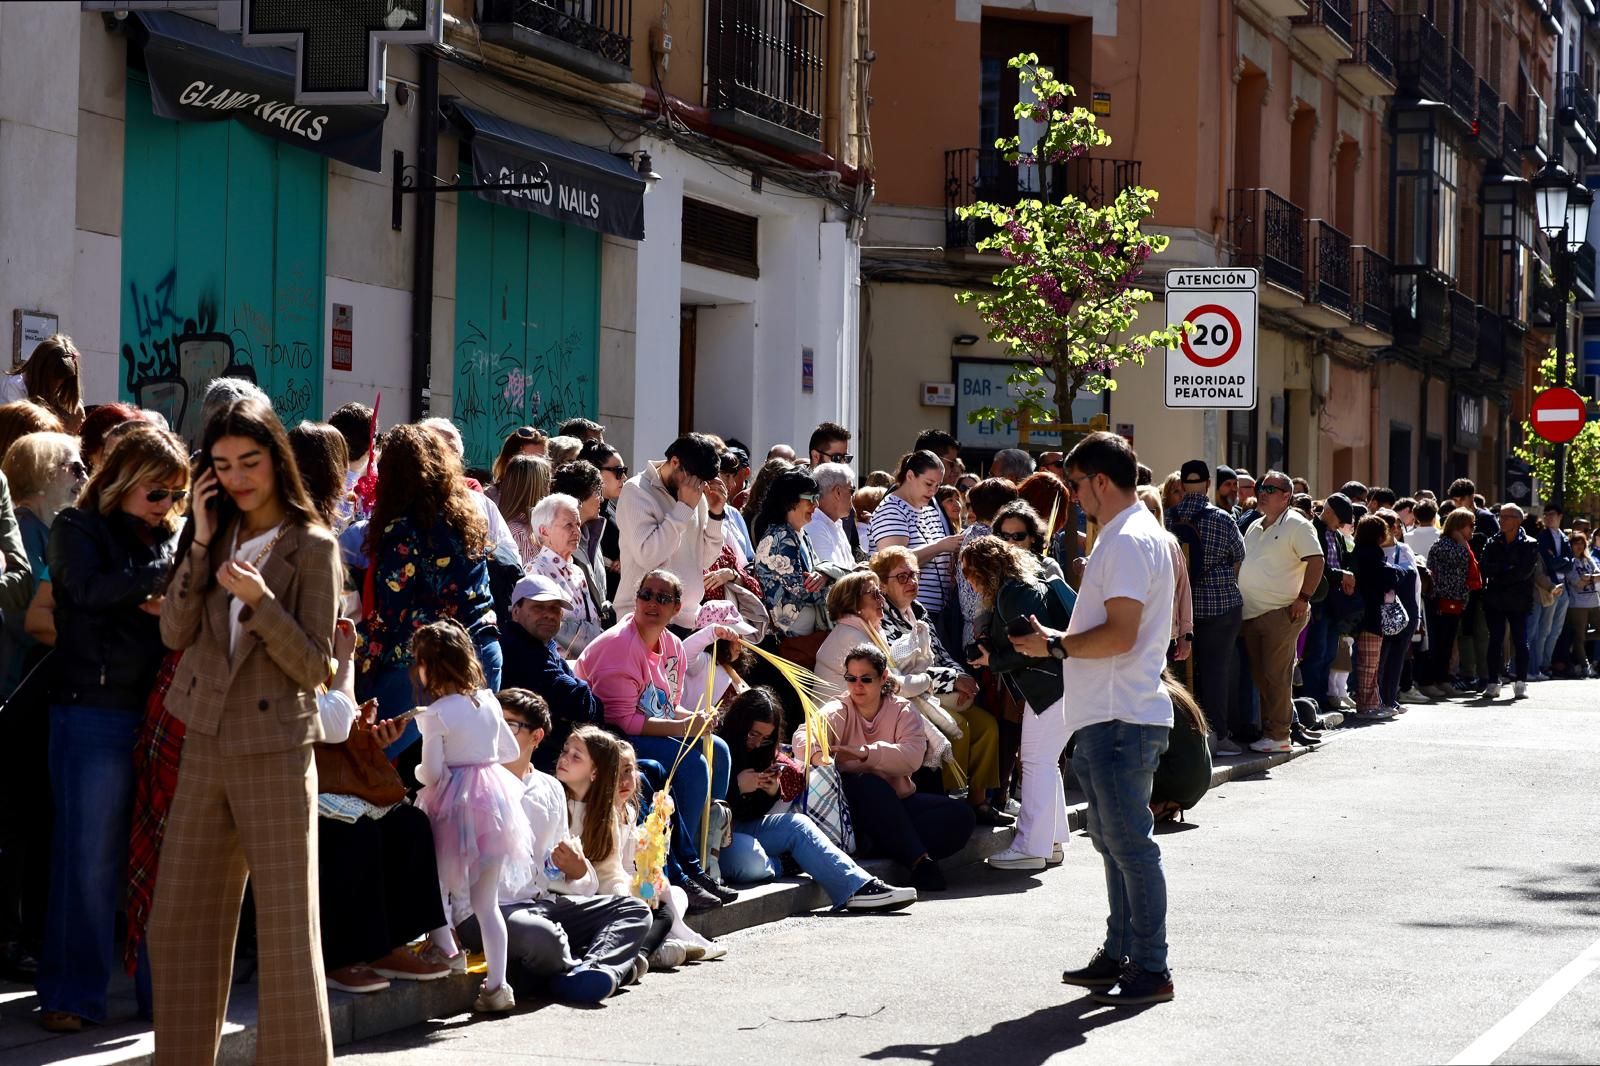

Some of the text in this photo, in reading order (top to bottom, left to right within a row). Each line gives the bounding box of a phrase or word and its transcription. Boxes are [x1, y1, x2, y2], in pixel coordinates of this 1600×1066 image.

[253, 100, 329, 141] NAILS
[499, 166, 600, 219] GLAMO NAILS
[1177, 271, 1247, 286] ATENCIÓN
[1192, 324, 1229, 346] 20
[261, 341, 313, 369] TONTO
[962, 378, 991, 396] BAR
[1173, 375, 1246, 385] PRIORIDAD
[1175, 387, 1244, 398] PEATONAL
